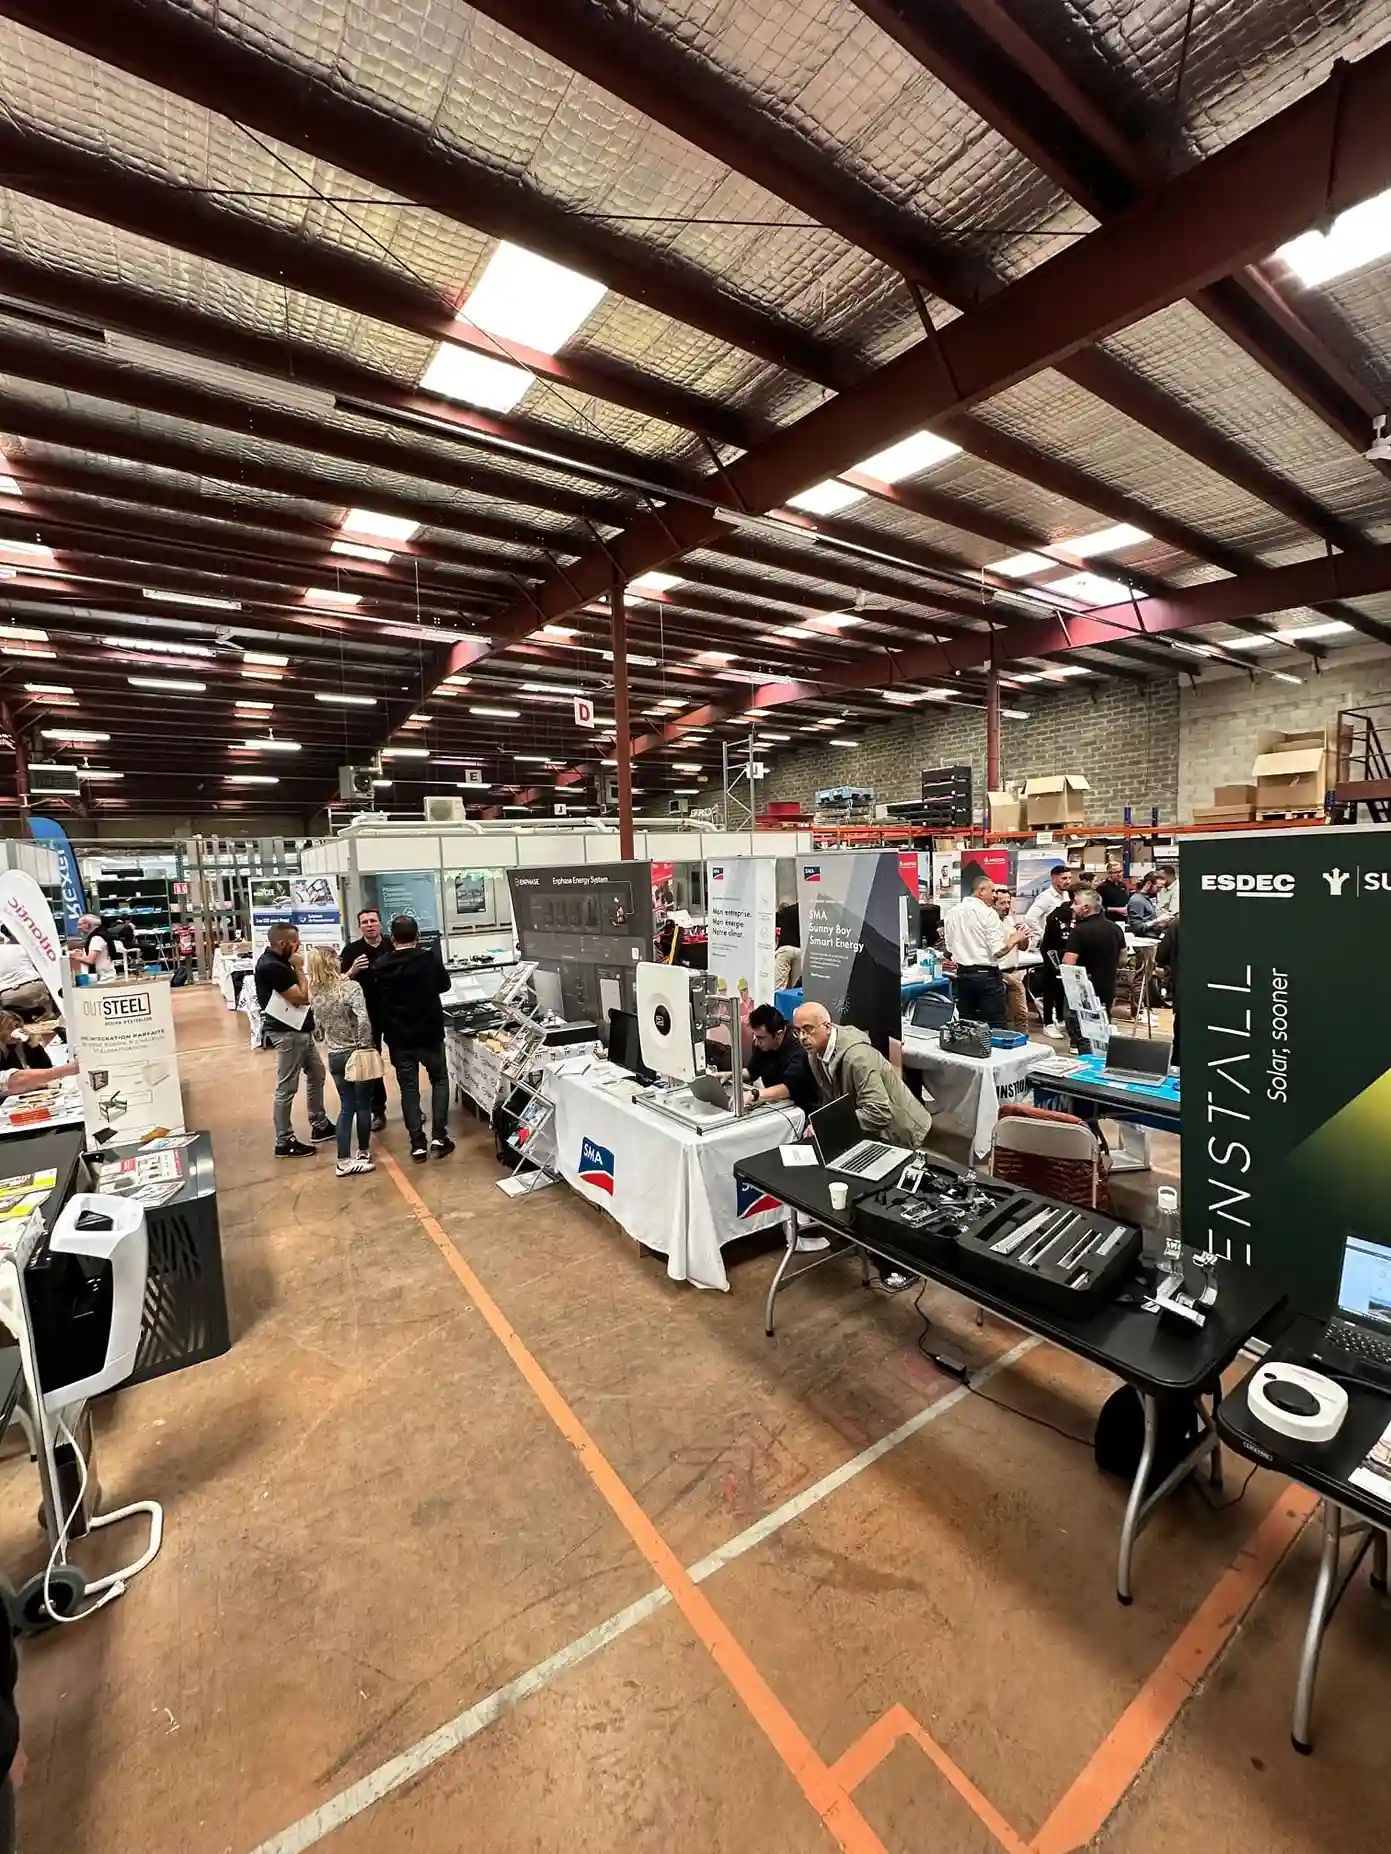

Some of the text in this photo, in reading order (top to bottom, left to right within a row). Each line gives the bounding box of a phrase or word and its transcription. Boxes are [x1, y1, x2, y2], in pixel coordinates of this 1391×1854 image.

[579, 703, 590, 722] D
[470, 771, 477, 781] E
[573, 876, 590, 885] Energy
[590, 876, 608, 884] System
[1201, 874, 1296, 891] ESDEC
[808, 909, 828, 920] SMA
[808, 923, 852, 937] Sunny Boy
[809, 936, 864, 952] Smart Energy
[1266, 967, 1291, 1103] Solar, sooner
[584, 1143, 604, 1165] SMA
